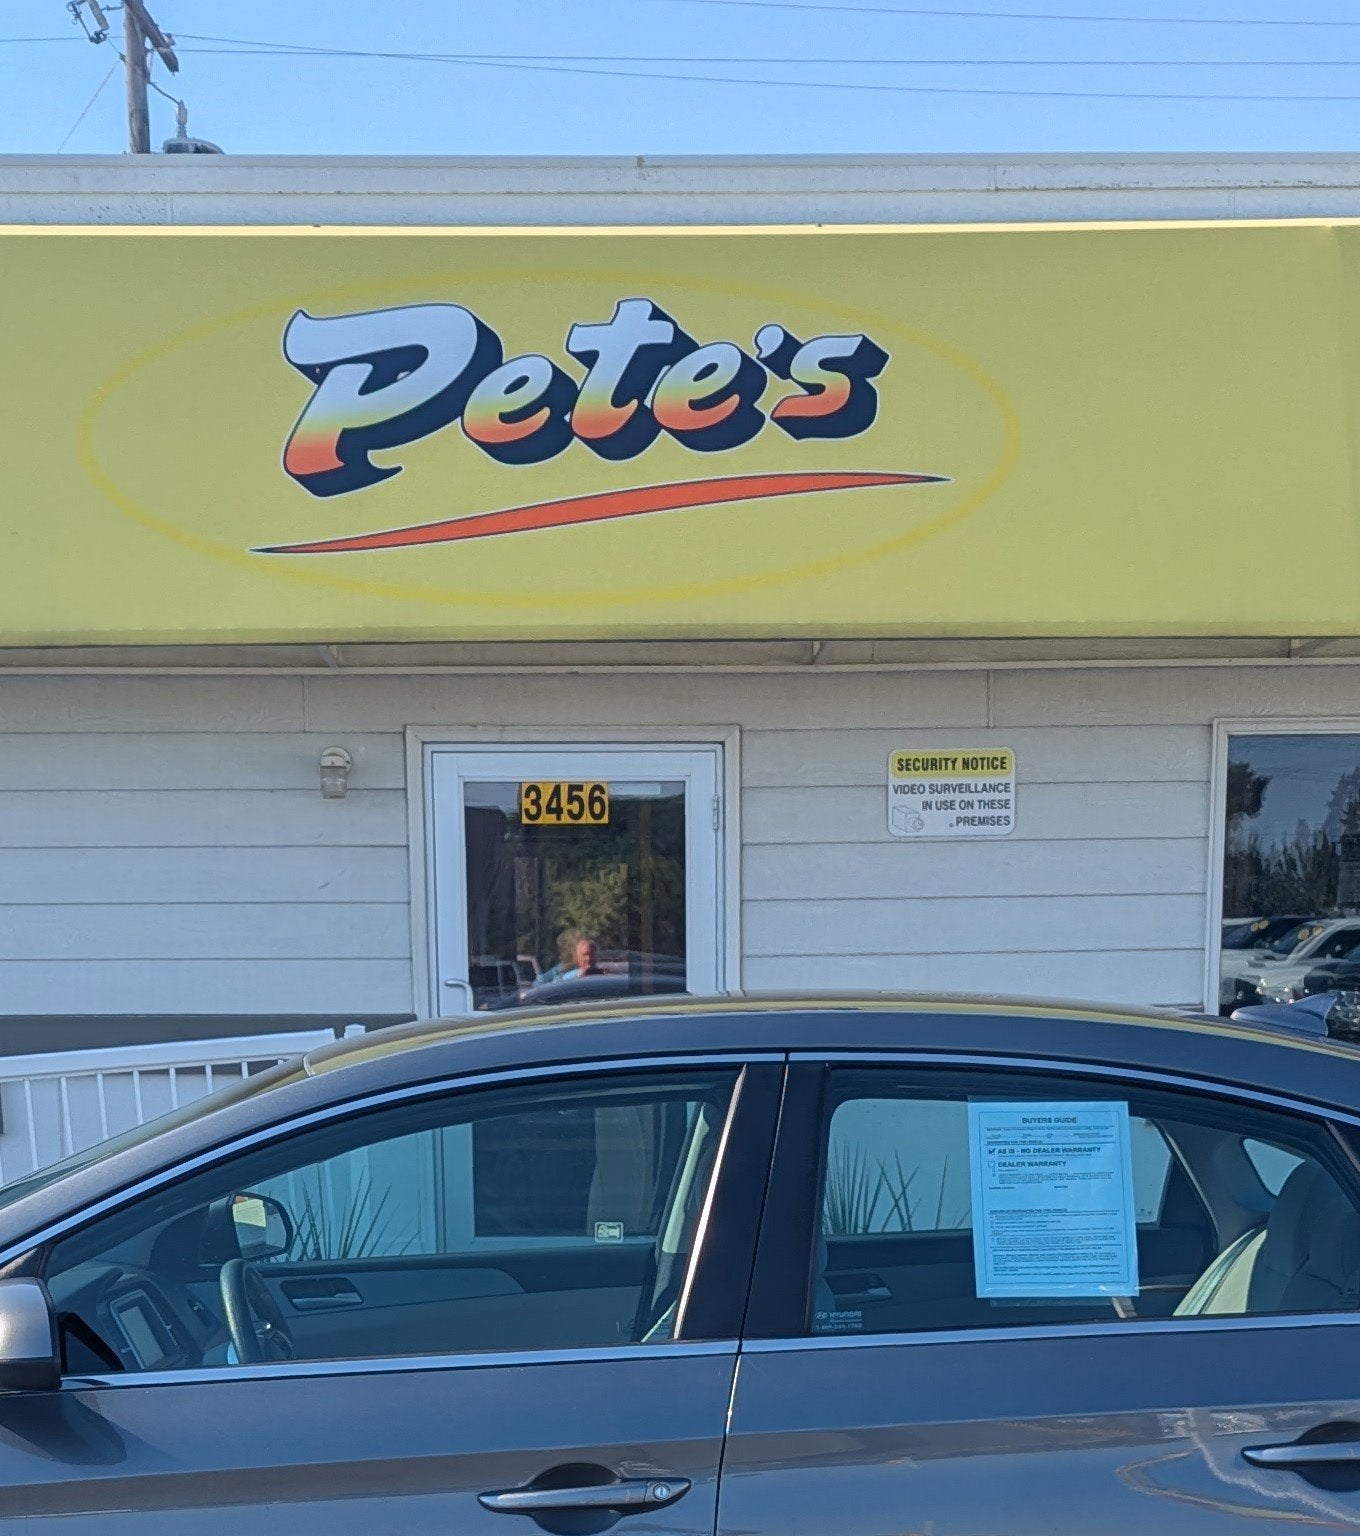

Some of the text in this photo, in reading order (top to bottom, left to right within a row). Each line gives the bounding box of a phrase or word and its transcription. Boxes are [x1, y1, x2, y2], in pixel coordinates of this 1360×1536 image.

[283, 298, 890, 497] Pete's
[897, 756, 1007, 771] SECURITY NOTICE
[893, 783, 1011, 795] VIDEO SURVEILLANCE
[524, 784, 606, 821] 3456
[922, 799, 1011, 811] IN USE ON THESE
[956, 816, 1011, 827] PREMISES
[1053, 1116, 1077, 1124] GUIDE
[1062, 1146, 1101, 1154] WARRANTY
